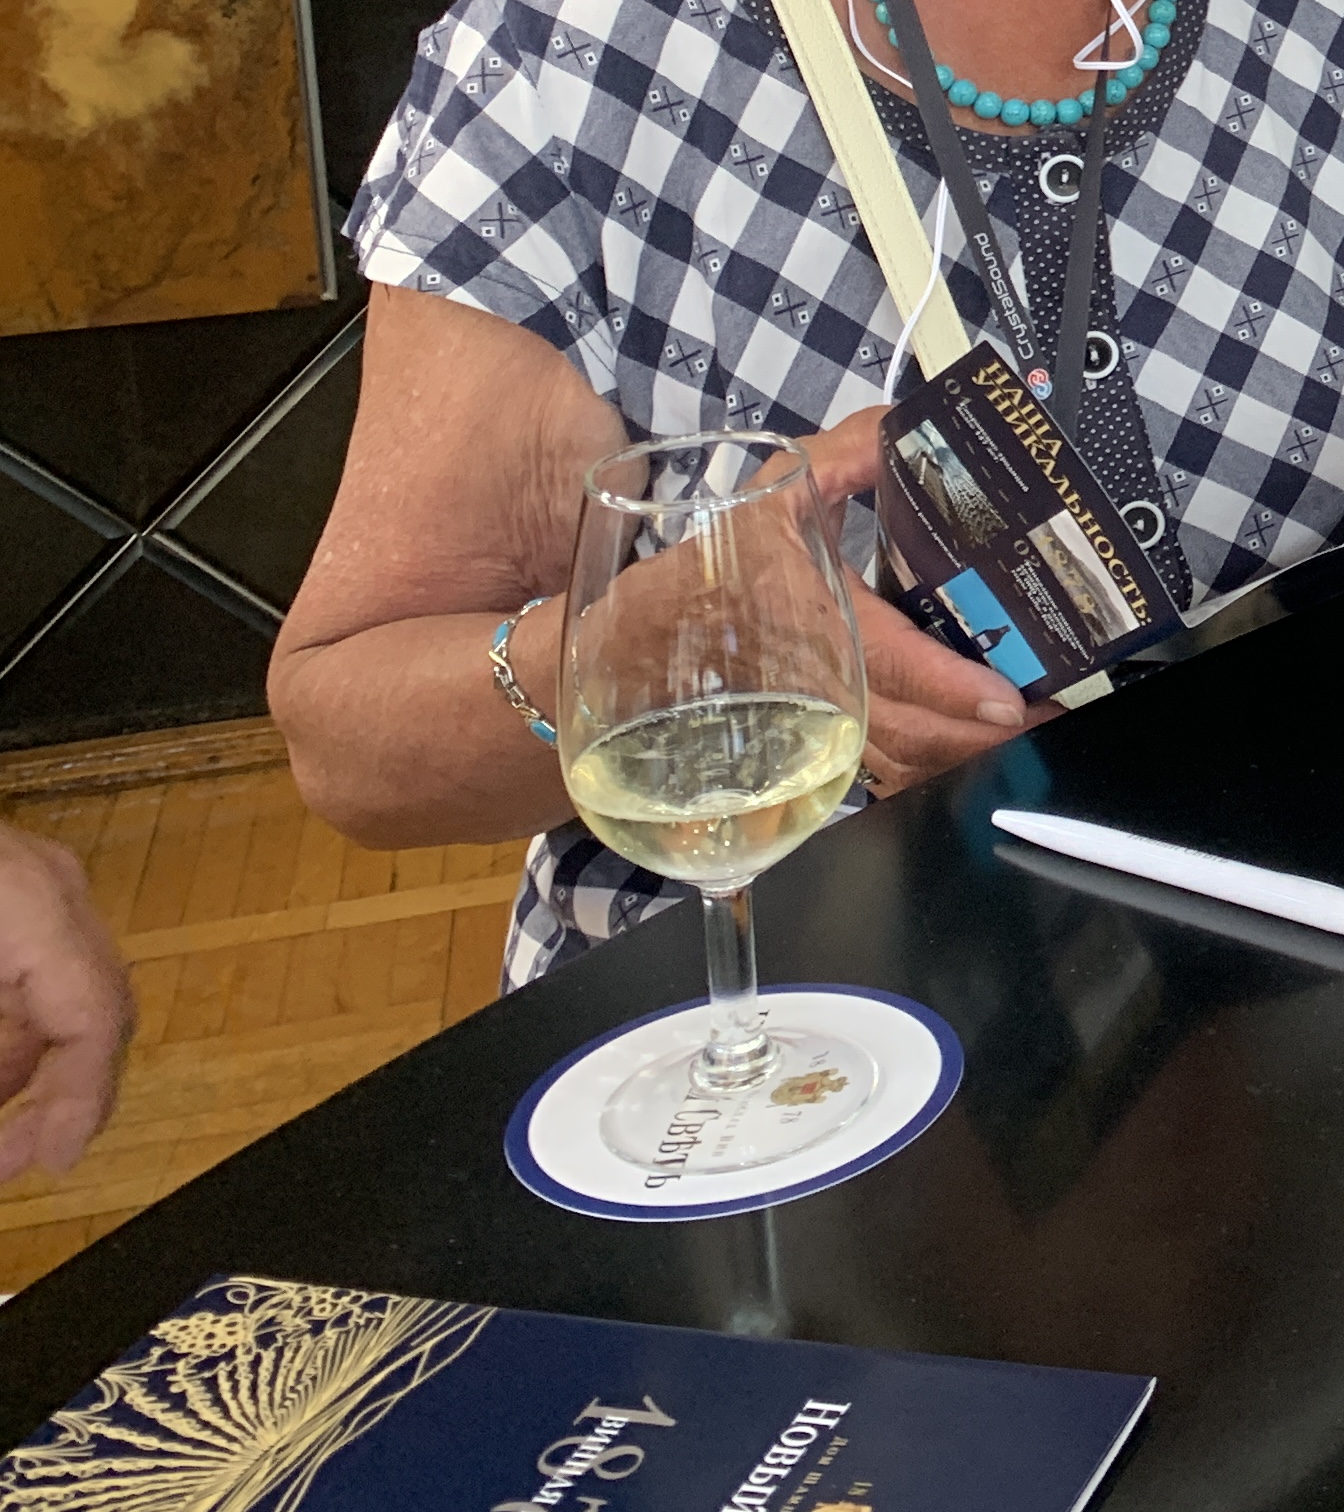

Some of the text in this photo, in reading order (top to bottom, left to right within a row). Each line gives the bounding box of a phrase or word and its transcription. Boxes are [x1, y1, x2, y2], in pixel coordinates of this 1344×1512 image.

[974, 232, 1034, 360] CrystalSound
[985, 359, 1063, 457] НАША
[972, 367, 1152, 626] УНИКАЛЬНОСТЬ:
